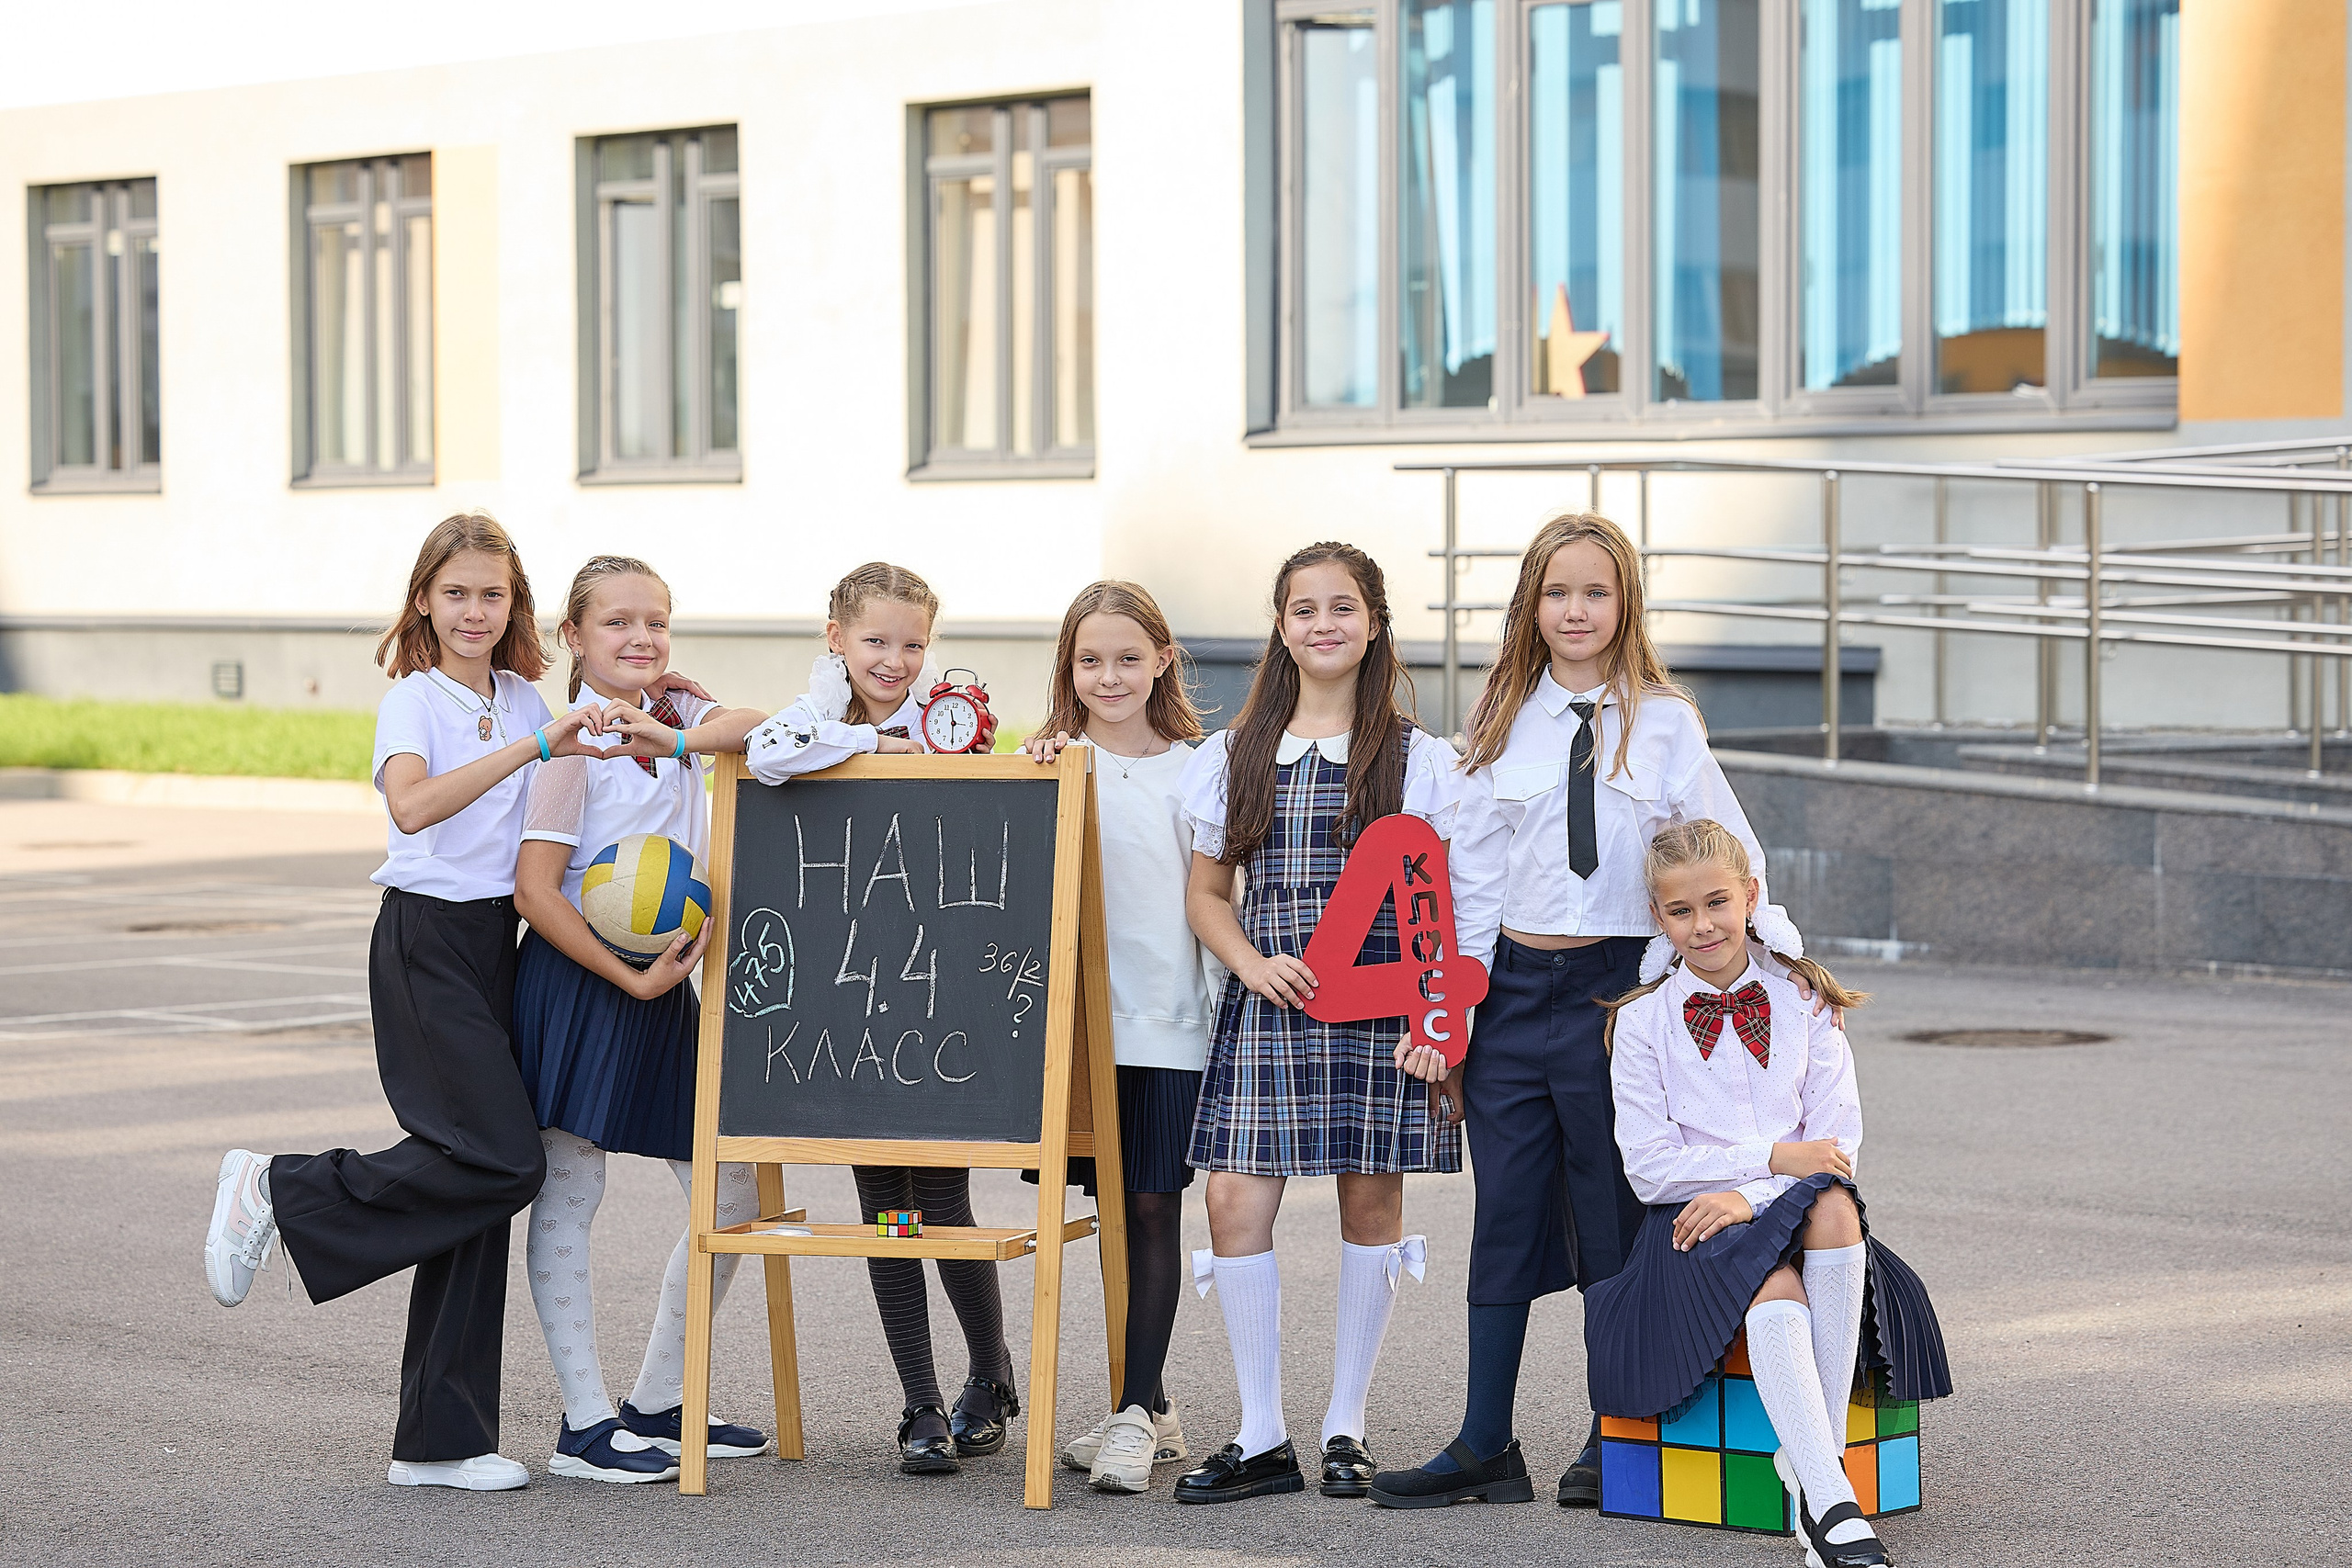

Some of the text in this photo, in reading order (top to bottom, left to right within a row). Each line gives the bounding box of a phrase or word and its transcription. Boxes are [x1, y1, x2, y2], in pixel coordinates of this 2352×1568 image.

[794, 812, 1010, 915] НАШ
[834, 919, 937, 1020] 4.4
[1300, 814, 1490, 1069] 4
[764, 1021, 978, 1086] КЛАСС
